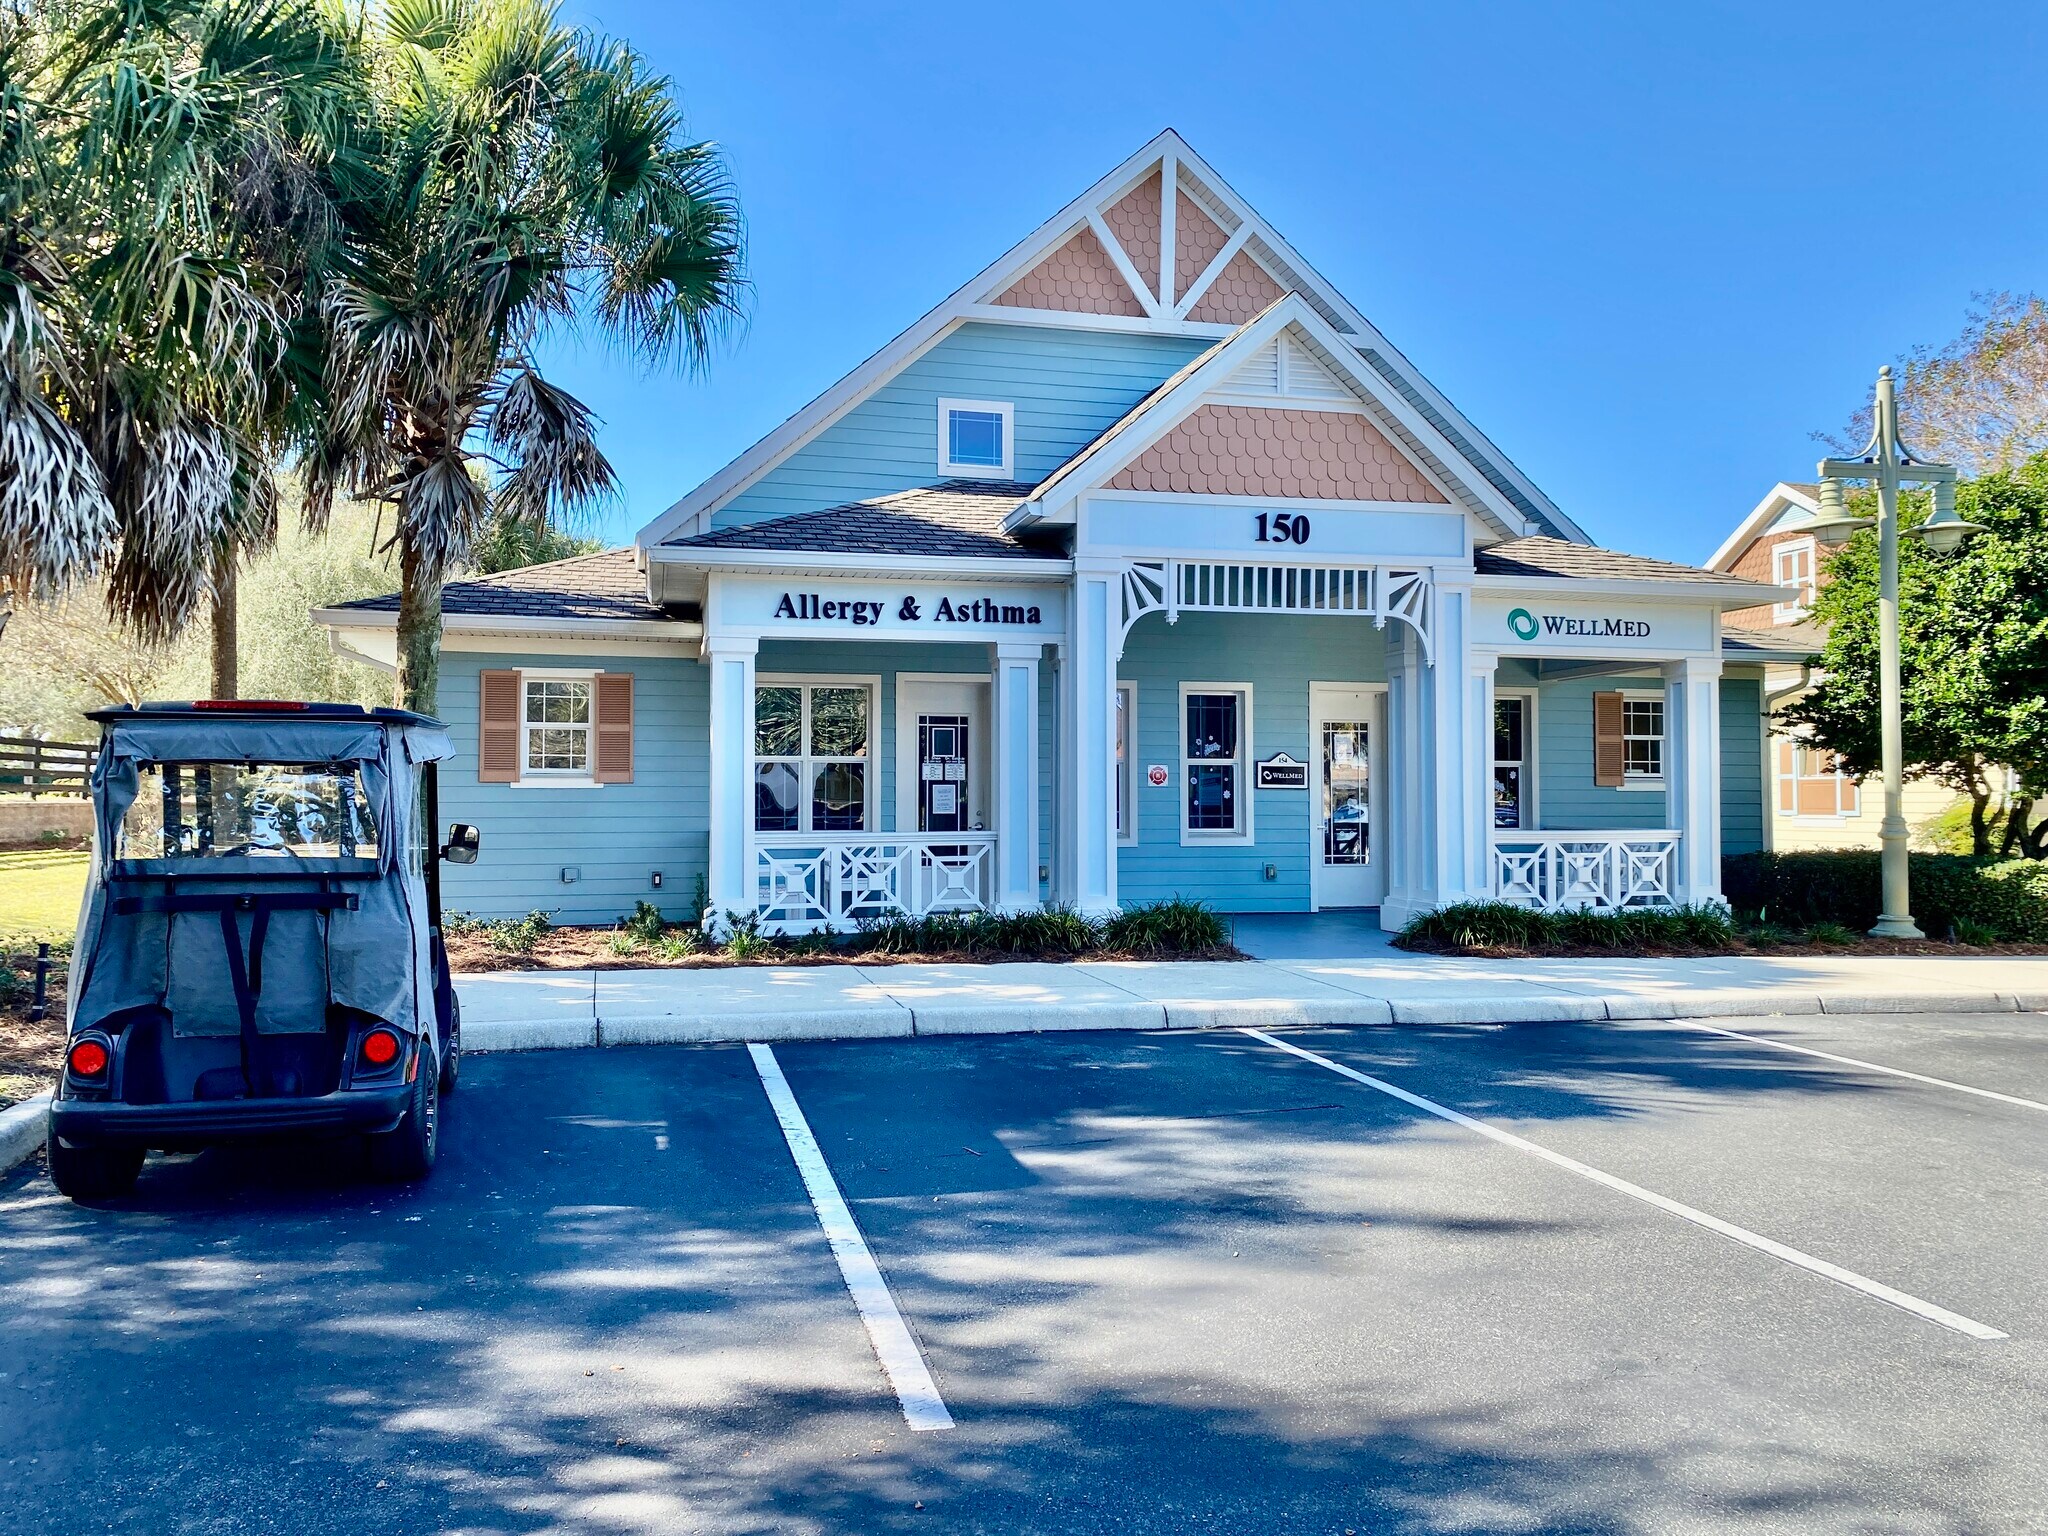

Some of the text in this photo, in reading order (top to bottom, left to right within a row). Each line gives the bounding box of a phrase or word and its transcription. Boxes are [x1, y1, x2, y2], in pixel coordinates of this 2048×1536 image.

[1254, 512, 1311, 545] 150
[774, 592, 1043, 626] Allergy & Asthma
